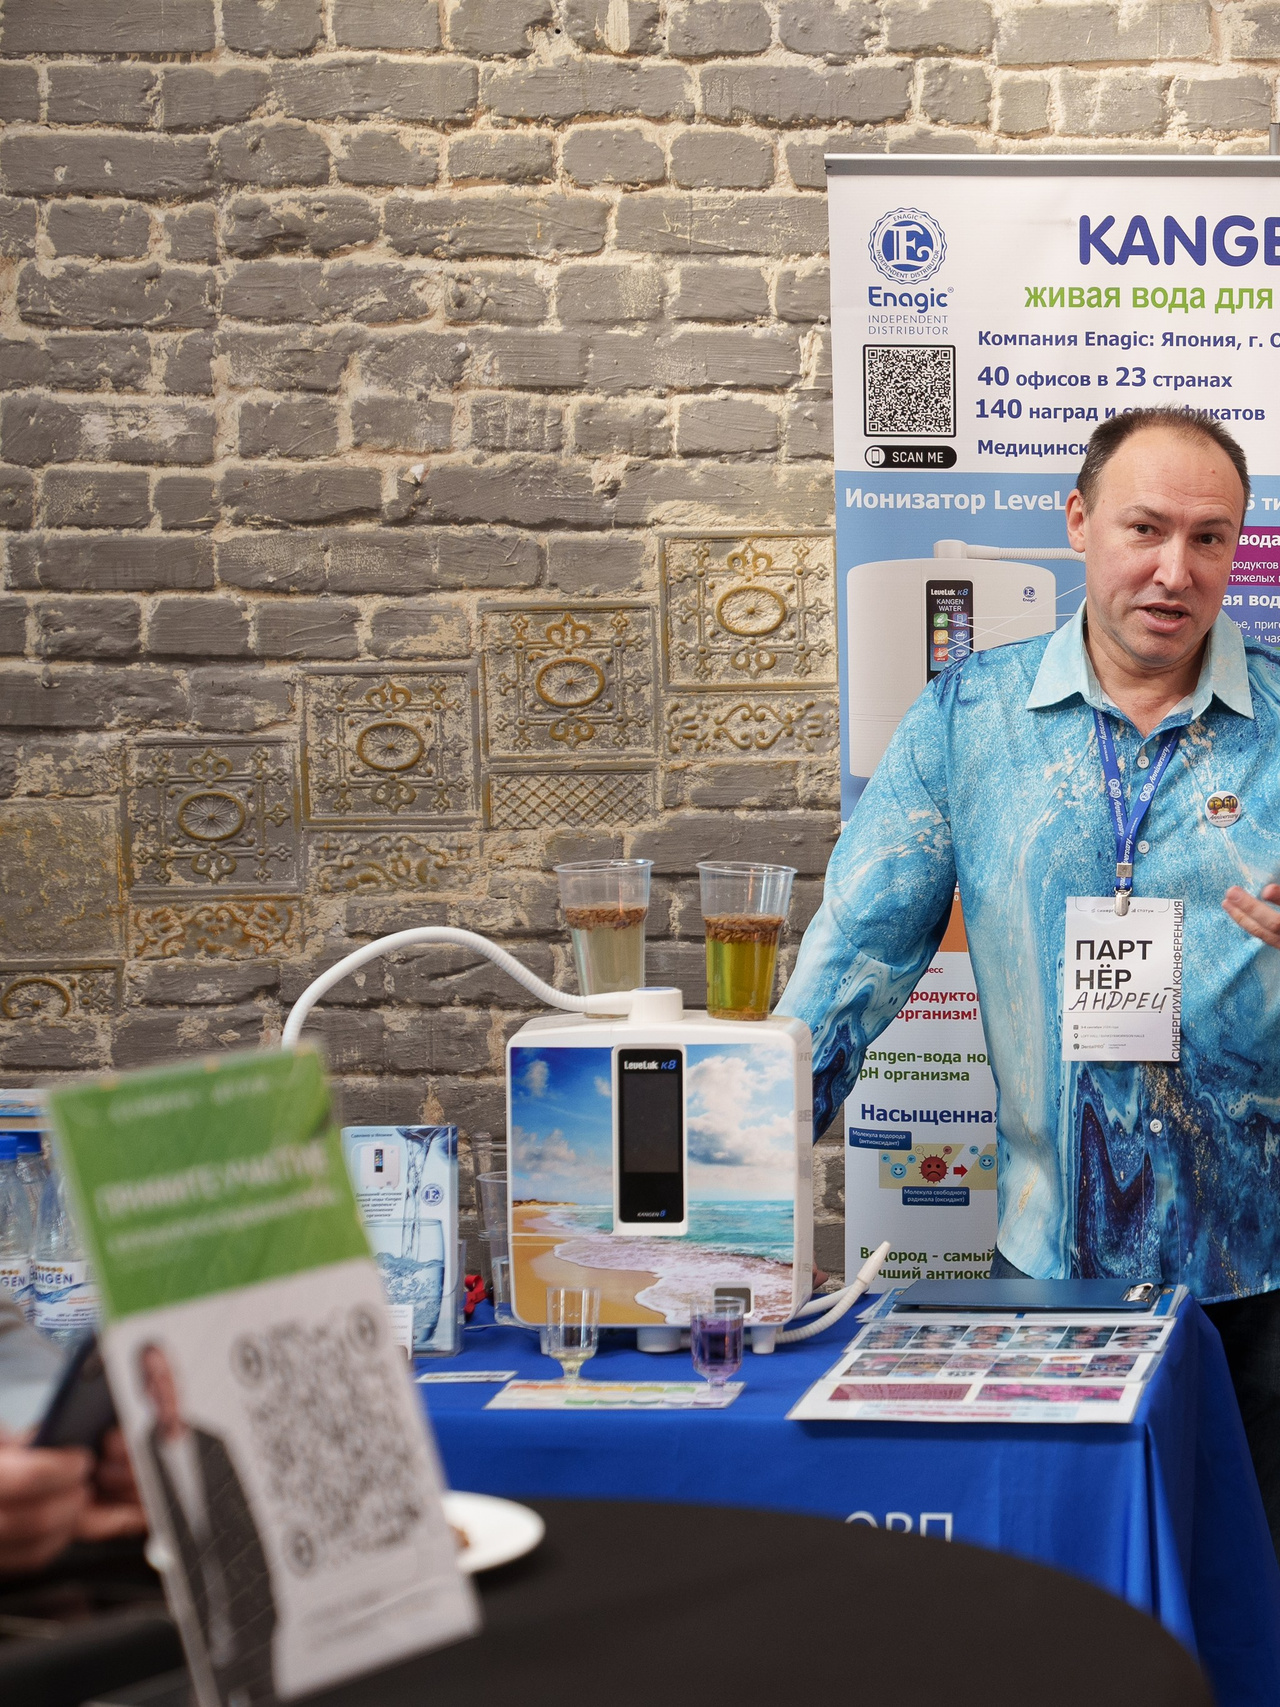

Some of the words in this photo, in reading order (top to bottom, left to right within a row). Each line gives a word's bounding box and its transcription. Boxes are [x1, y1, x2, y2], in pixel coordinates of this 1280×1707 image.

[1024, 286, 1121, 309] живая
[1131, 287, 1206, 313] вода
[1214, 288, 1273, 314] для
[868, 315, 948, 324] INDEPENDENT
[868, 326, 949, 335] DISTRIBUTOR
[978, 331, 1078, 346] Компания
[1085, 331, 1154, 350] Enagic:
[1161, 332, 1241, 350] Япония,
[1248, 336, 1264, 348] г.
[977, 366, 1009, 386] 40
[1016, 371, 1091, 390] офисов
[1098, 374, 1109, 386] в
[1116, 367, 1146, 387] 23
[1153, 374, 1233, 391] странах
[975, 399, 1023, 419] 140
[1029, 407, 1099, 422] наград
[1105, 407, 1117, 419] и
[892, 452, 925, 463] SCAN
[928, 452, 944, 463] ME
[845, 488, 986, 514] Ионизатор
[1230, 574, 1275, 583] тяжелых
[931, 588, 955, 596] LeveLuk
[1076, 940, 1153, 960] ПАРТ
[1173, 901, 1183, 986] КОНФЕРЕНЦИЯ
[1076, 964, 1132, 990] НЁР
[1171, 989, 1181, 1060] СИНЕРГИУМ
[624, 1060, 658, 1070] LeveLuk
[660, 1060, 677, 1070] K8
[884, 1069, 970, 1083] организма
[852, 1130, 878, 1138] Молекула
[879, 1132, 906, 1140] водорода
[943, 1249, 995, 1262] самый
